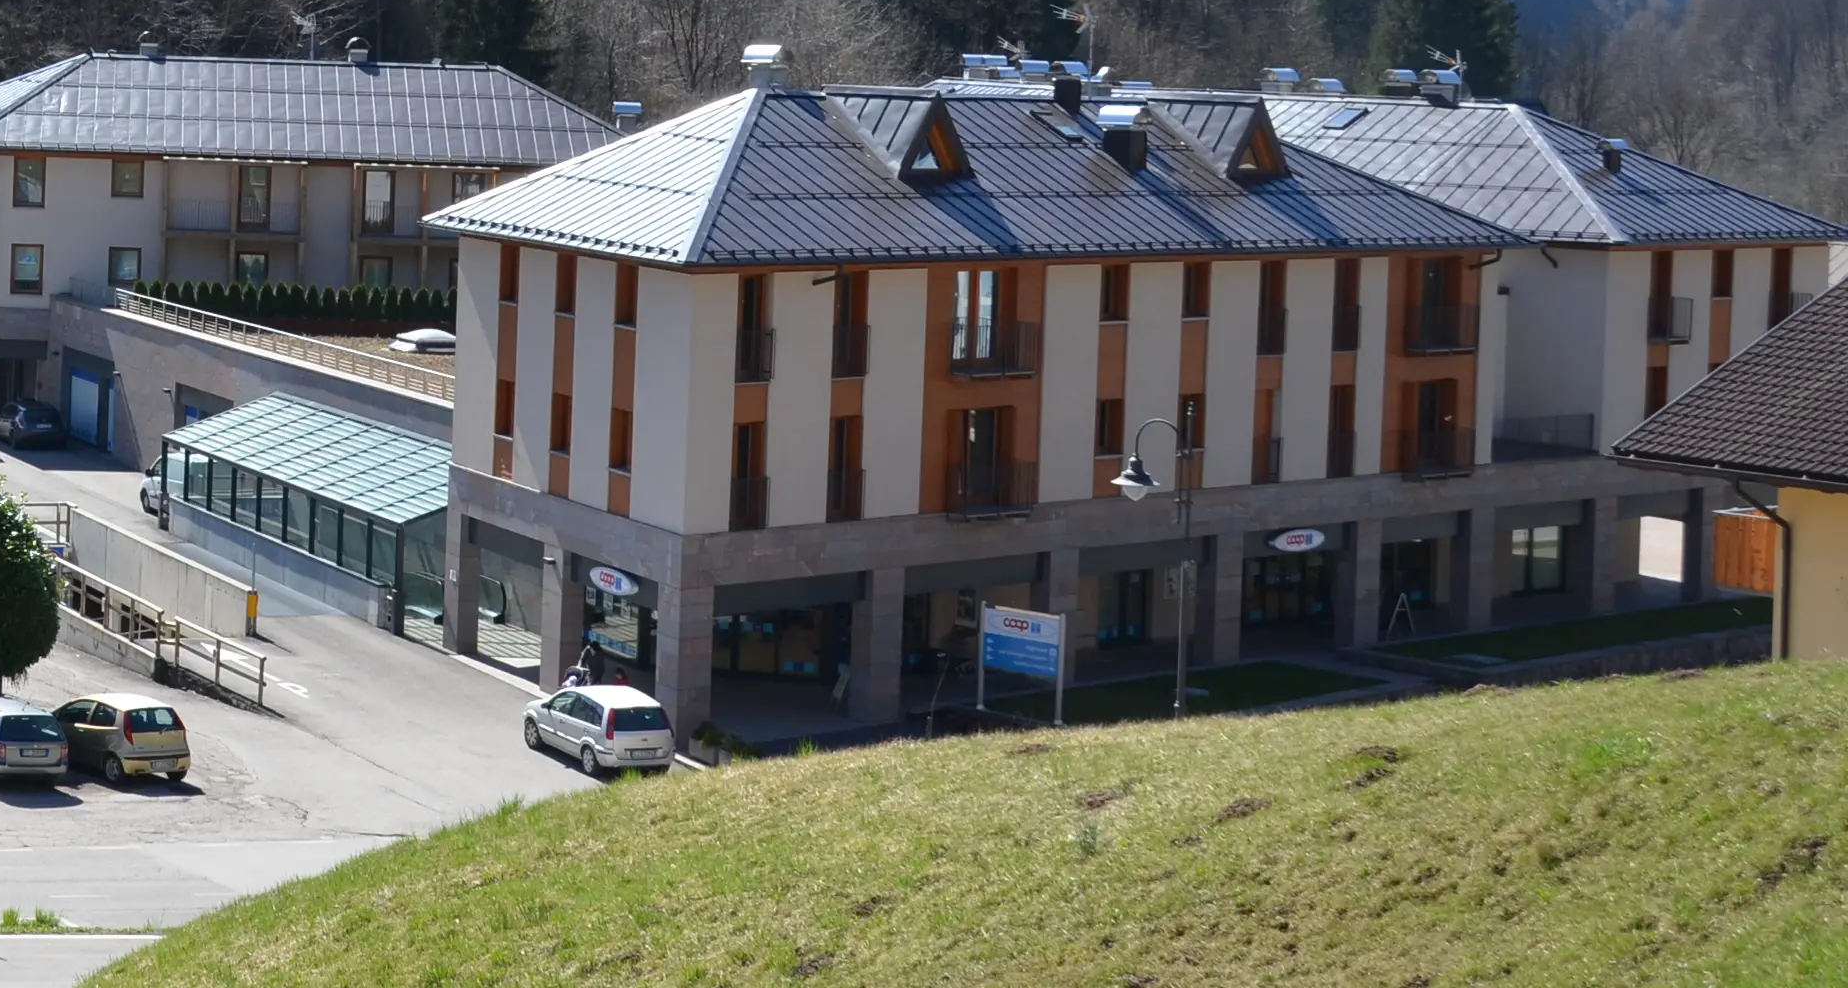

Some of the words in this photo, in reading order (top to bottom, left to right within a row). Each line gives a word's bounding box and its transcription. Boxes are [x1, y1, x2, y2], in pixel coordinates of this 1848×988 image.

[599, 571, 616, 588] coop
[1003, 617, 1029, 631] coop
[276, 682, 309, 698] P
